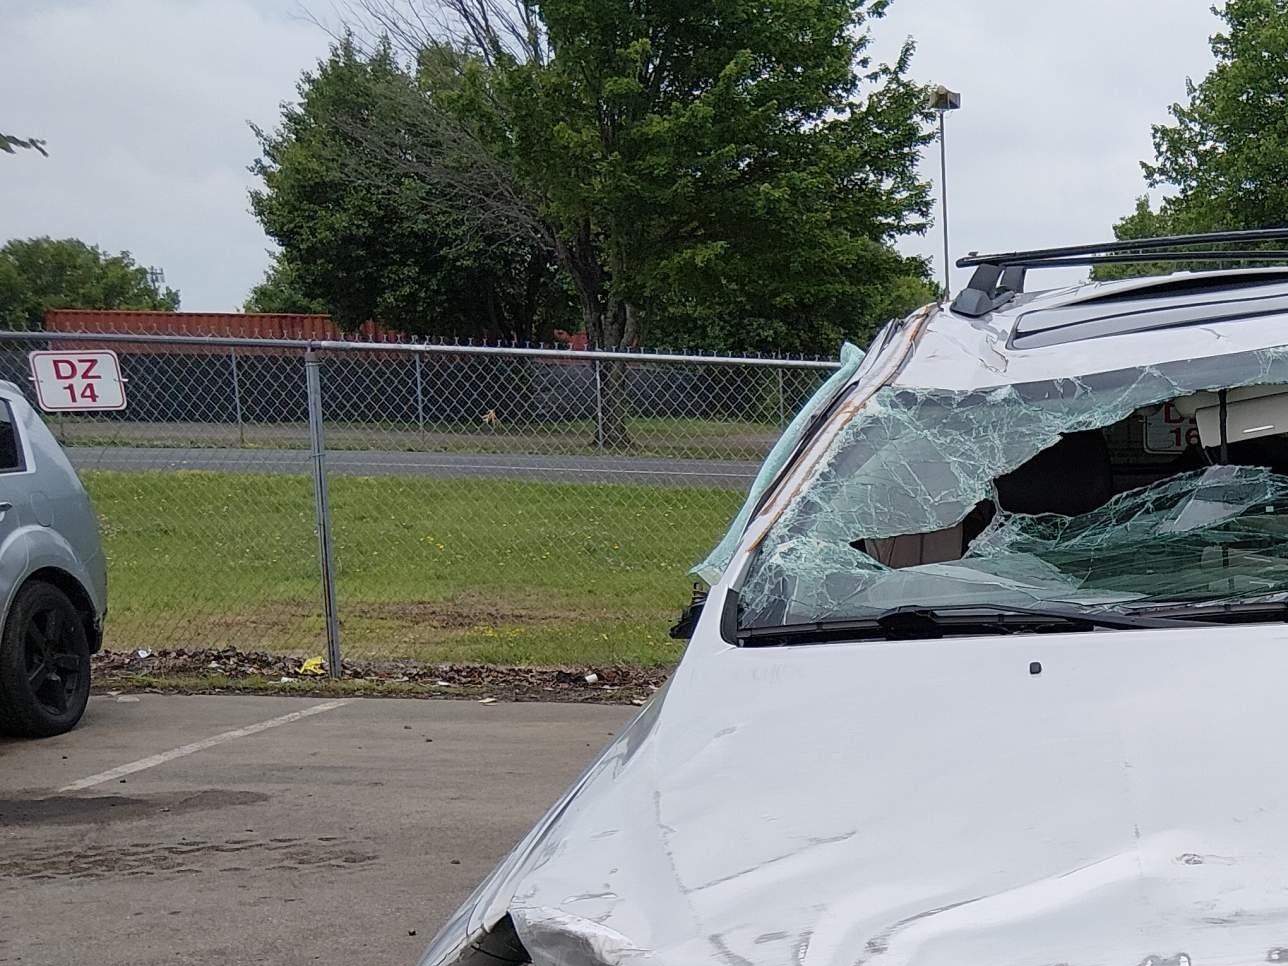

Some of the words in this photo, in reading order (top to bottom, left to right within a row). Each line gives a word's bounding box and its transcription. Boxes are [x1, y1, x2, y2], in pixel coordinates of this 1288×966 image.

[52, 359, 101, 380] DZ
[63, 383, 98, 402] 14
[1164, 399, 1196, 424] D
